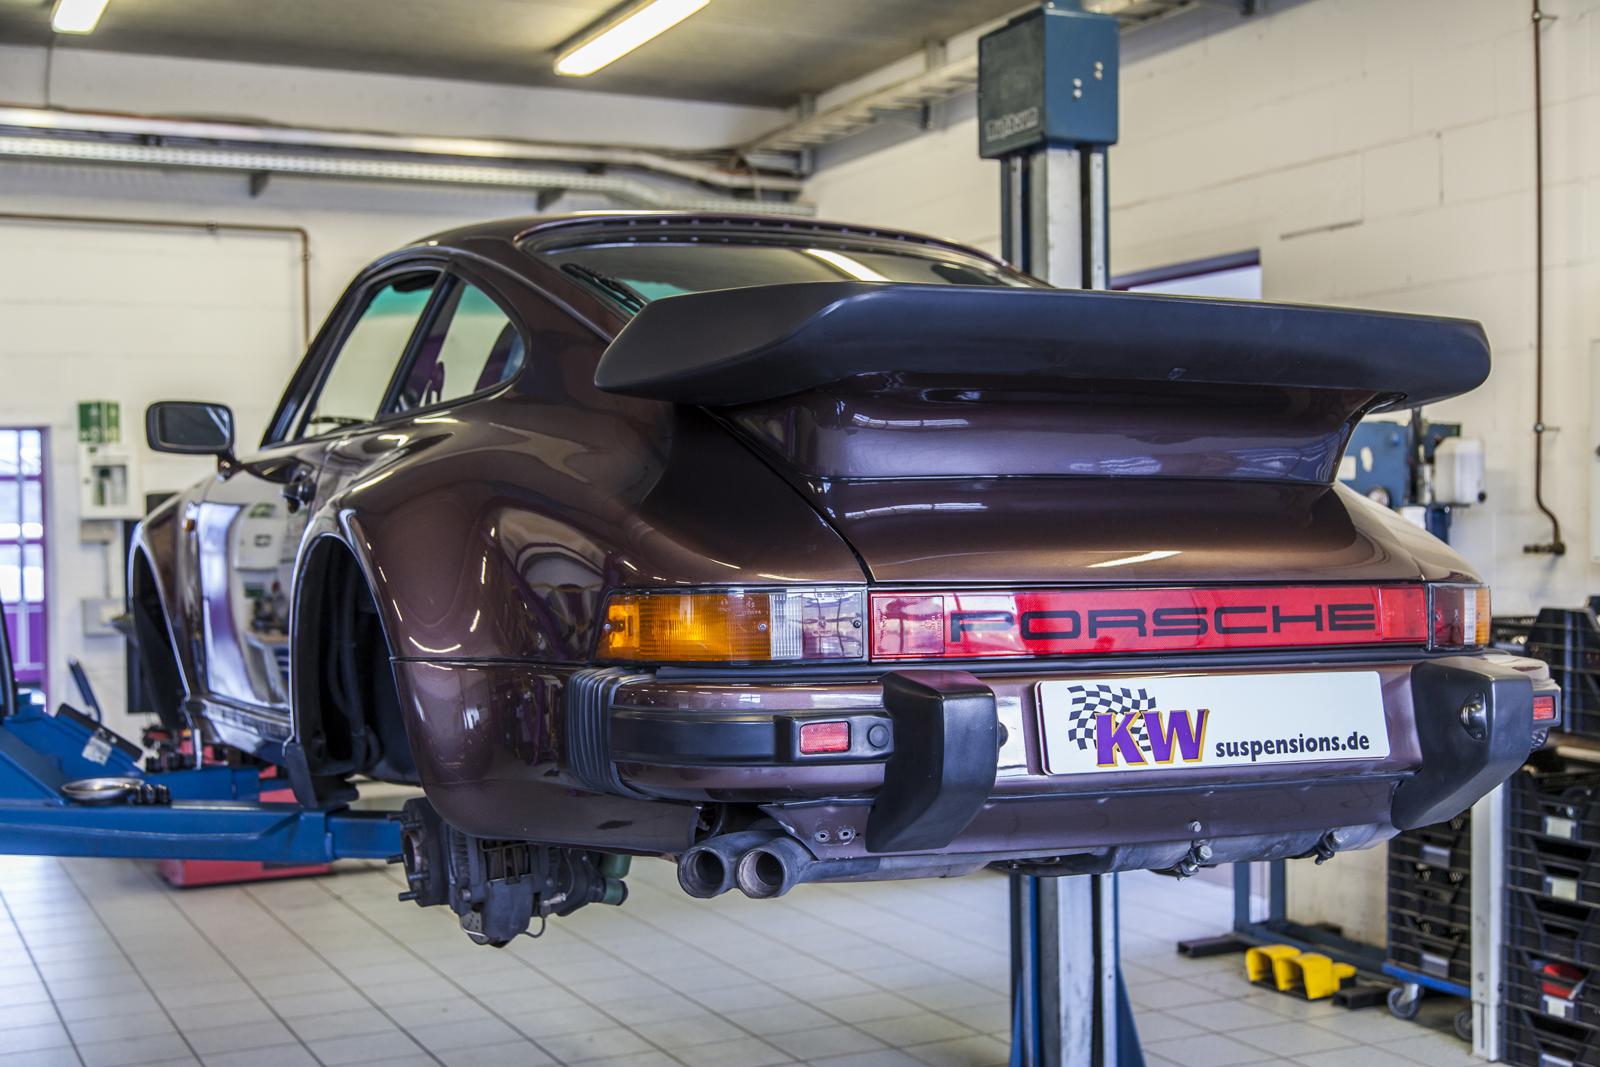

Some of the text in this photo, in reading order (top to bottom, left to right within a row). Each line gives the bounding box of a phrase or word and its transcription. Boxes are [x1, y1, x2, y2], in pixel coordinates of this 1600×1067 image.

[950, 603, 1376, 643] PORSCHE
[1094, 708, 1370, 768] KW suspensions.de
